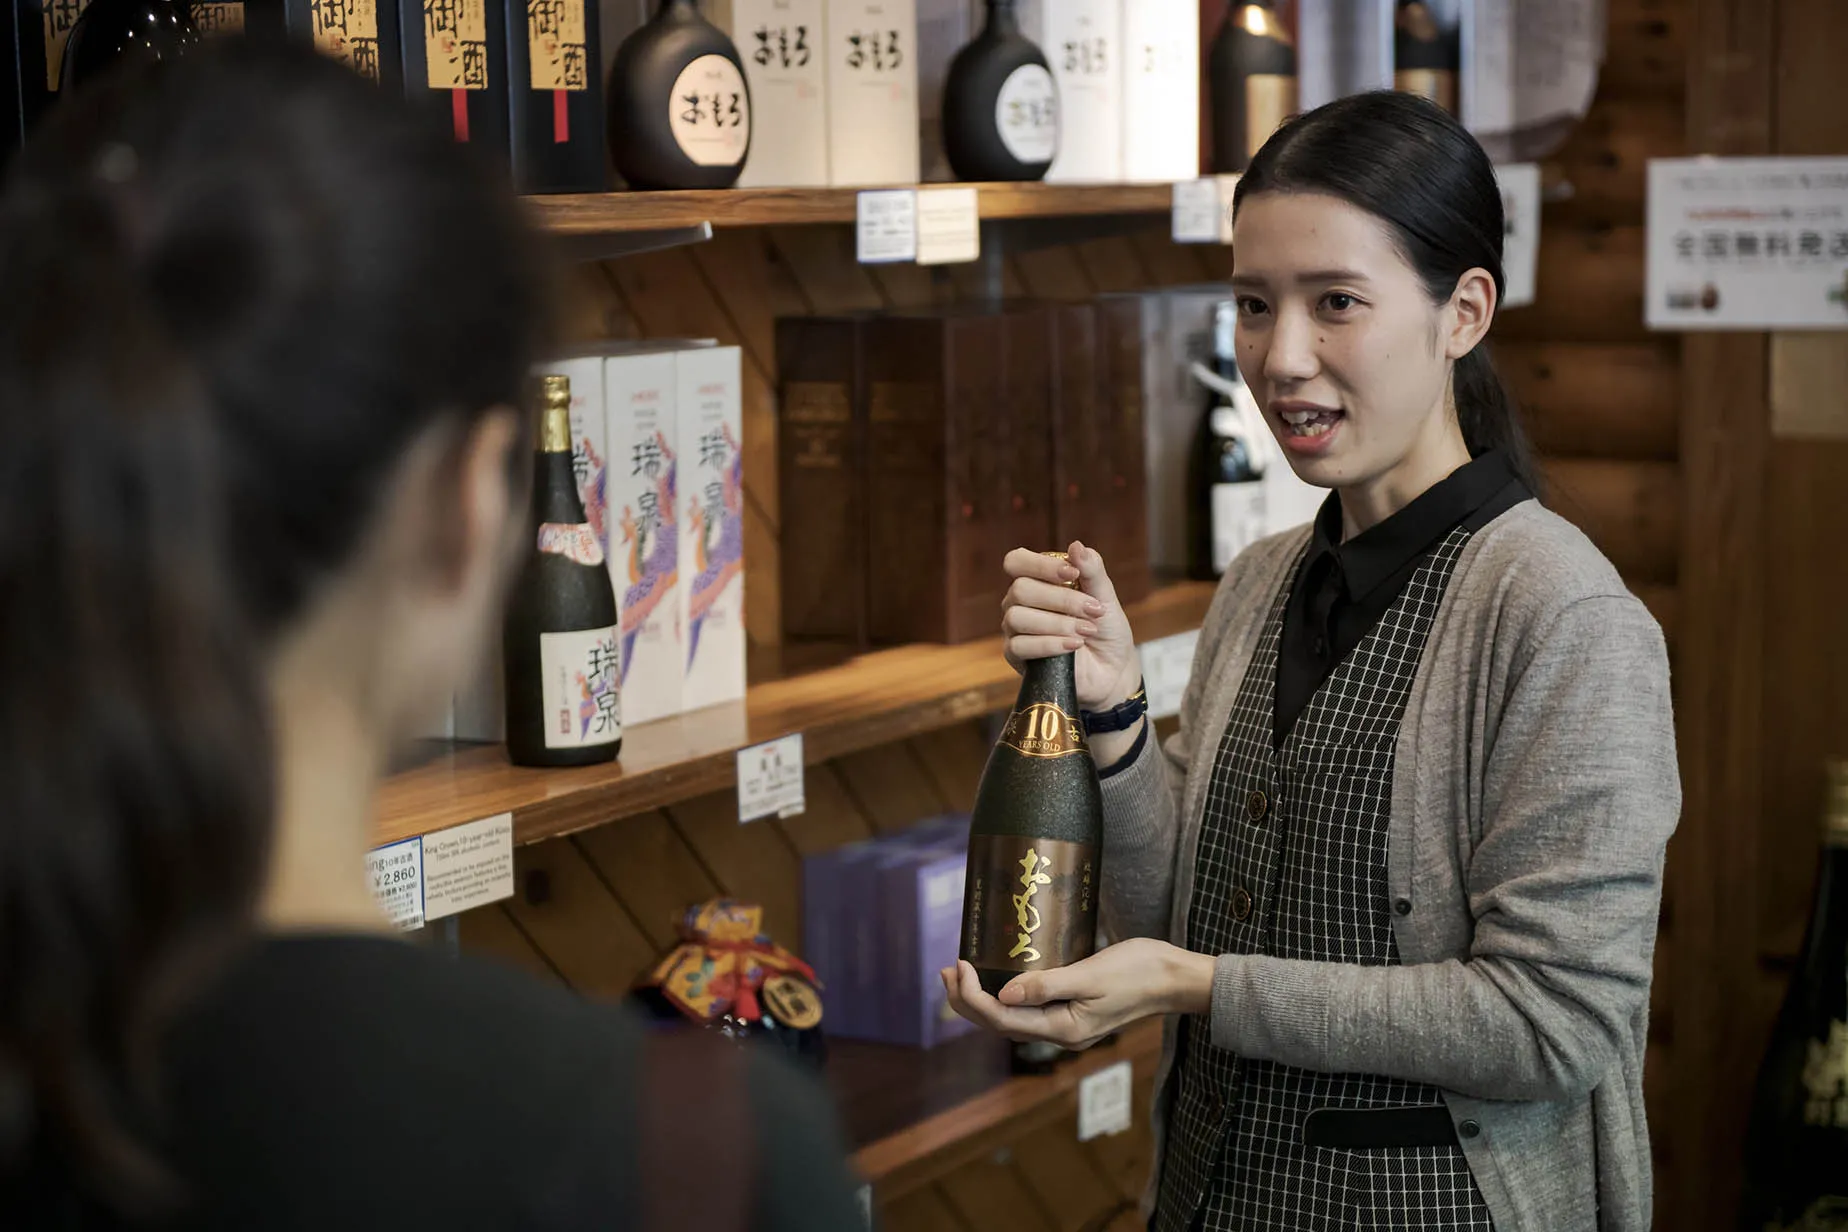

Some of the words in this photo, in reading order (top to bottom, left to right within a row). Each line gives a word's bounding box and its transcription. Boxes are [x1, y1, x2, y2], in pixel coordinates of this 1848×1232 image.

[754, 25, 811, 69] おもろ
[847, 28, 903, 71] おもろ
[682, 92, 742, 128] おもろ
[632, 436, 662, 529] 瑞泉
[698, 427, 727, 520] 瑞泉
[588, 639, 620, 734] 瑞泉
[1019, 740, 1042, 750] YEARS
[1043, 741, 1061, 752] OLD
[1024, 708, 1059, 741] 10
[1008, 847, 1052, 963] おもろ
